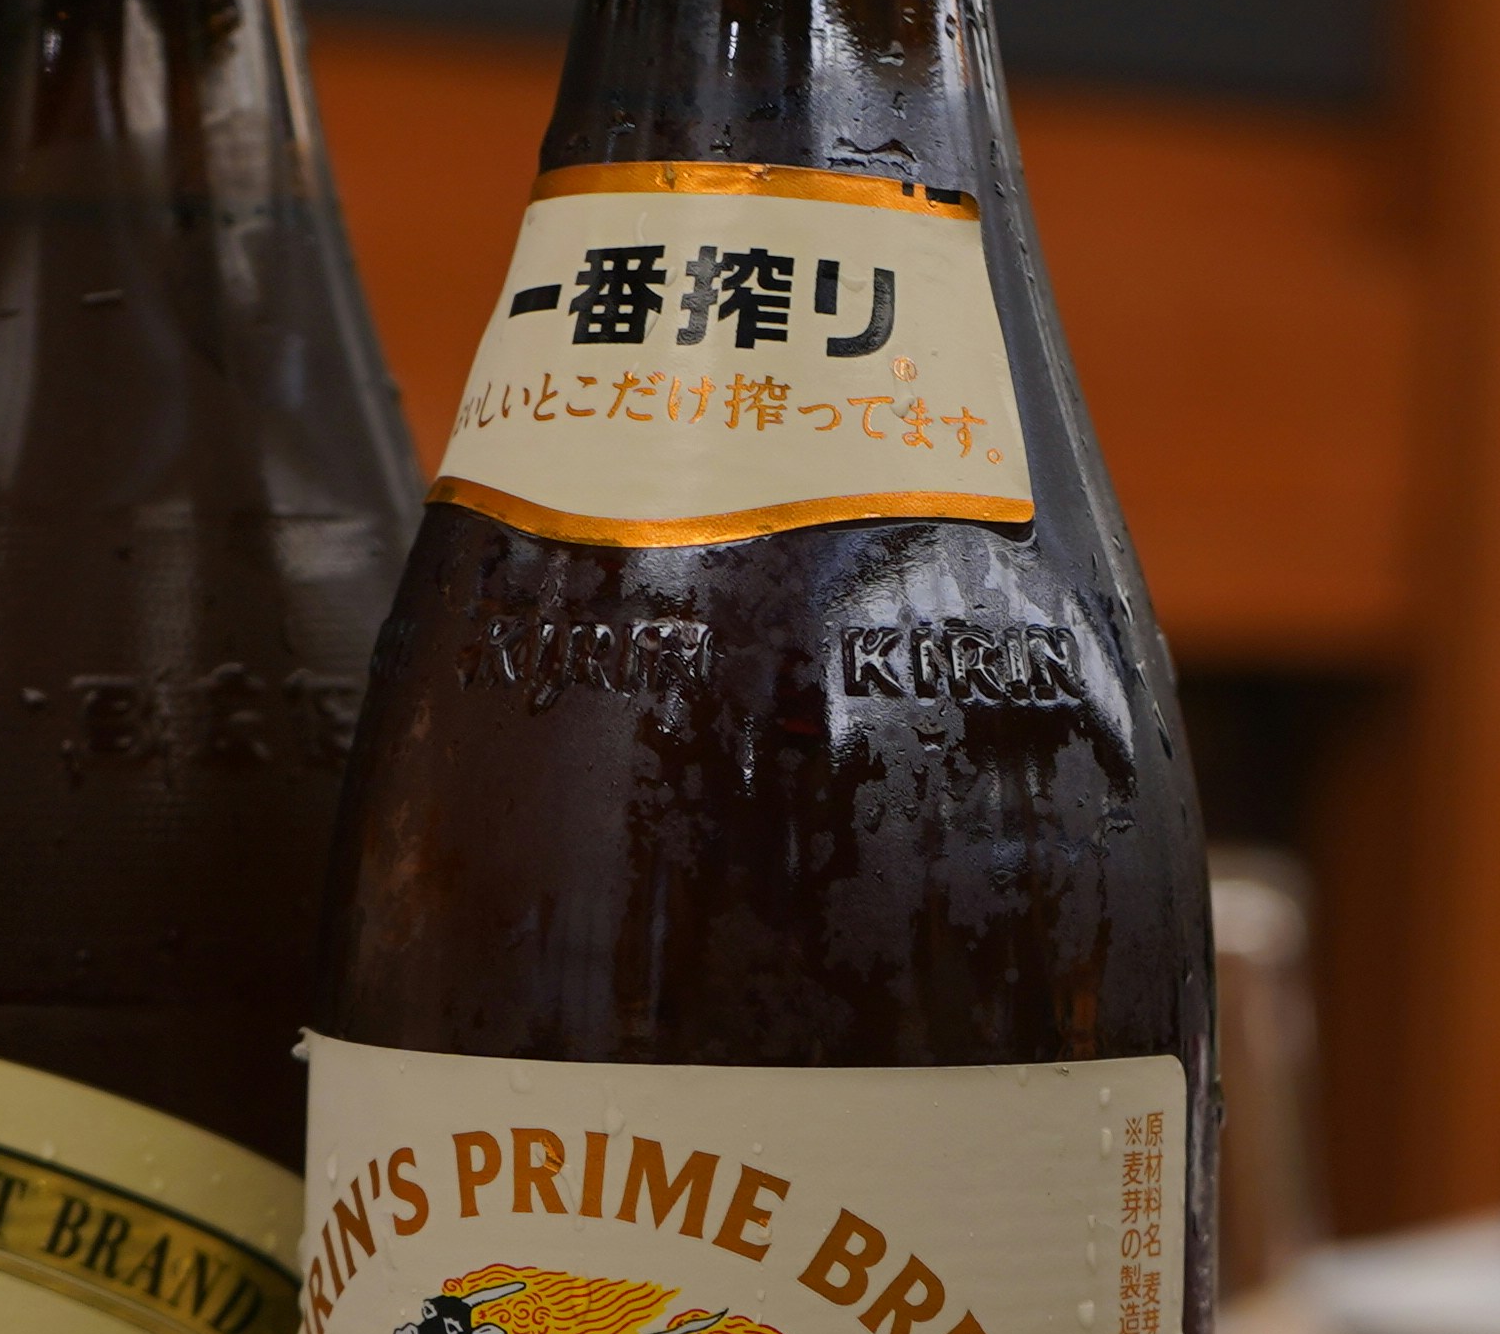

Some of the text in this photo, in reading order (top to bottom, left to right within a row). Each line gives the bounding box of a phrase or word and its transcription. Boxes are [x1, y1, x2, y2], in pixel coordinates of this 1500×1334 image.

[508, 245, 896, 358] 一番搾り
[841, 623, 1084, 702] KIRIN
[453, 1128, 791, 1264] PRIME
[1142, 1112, 1165, 1258] 原材料名
